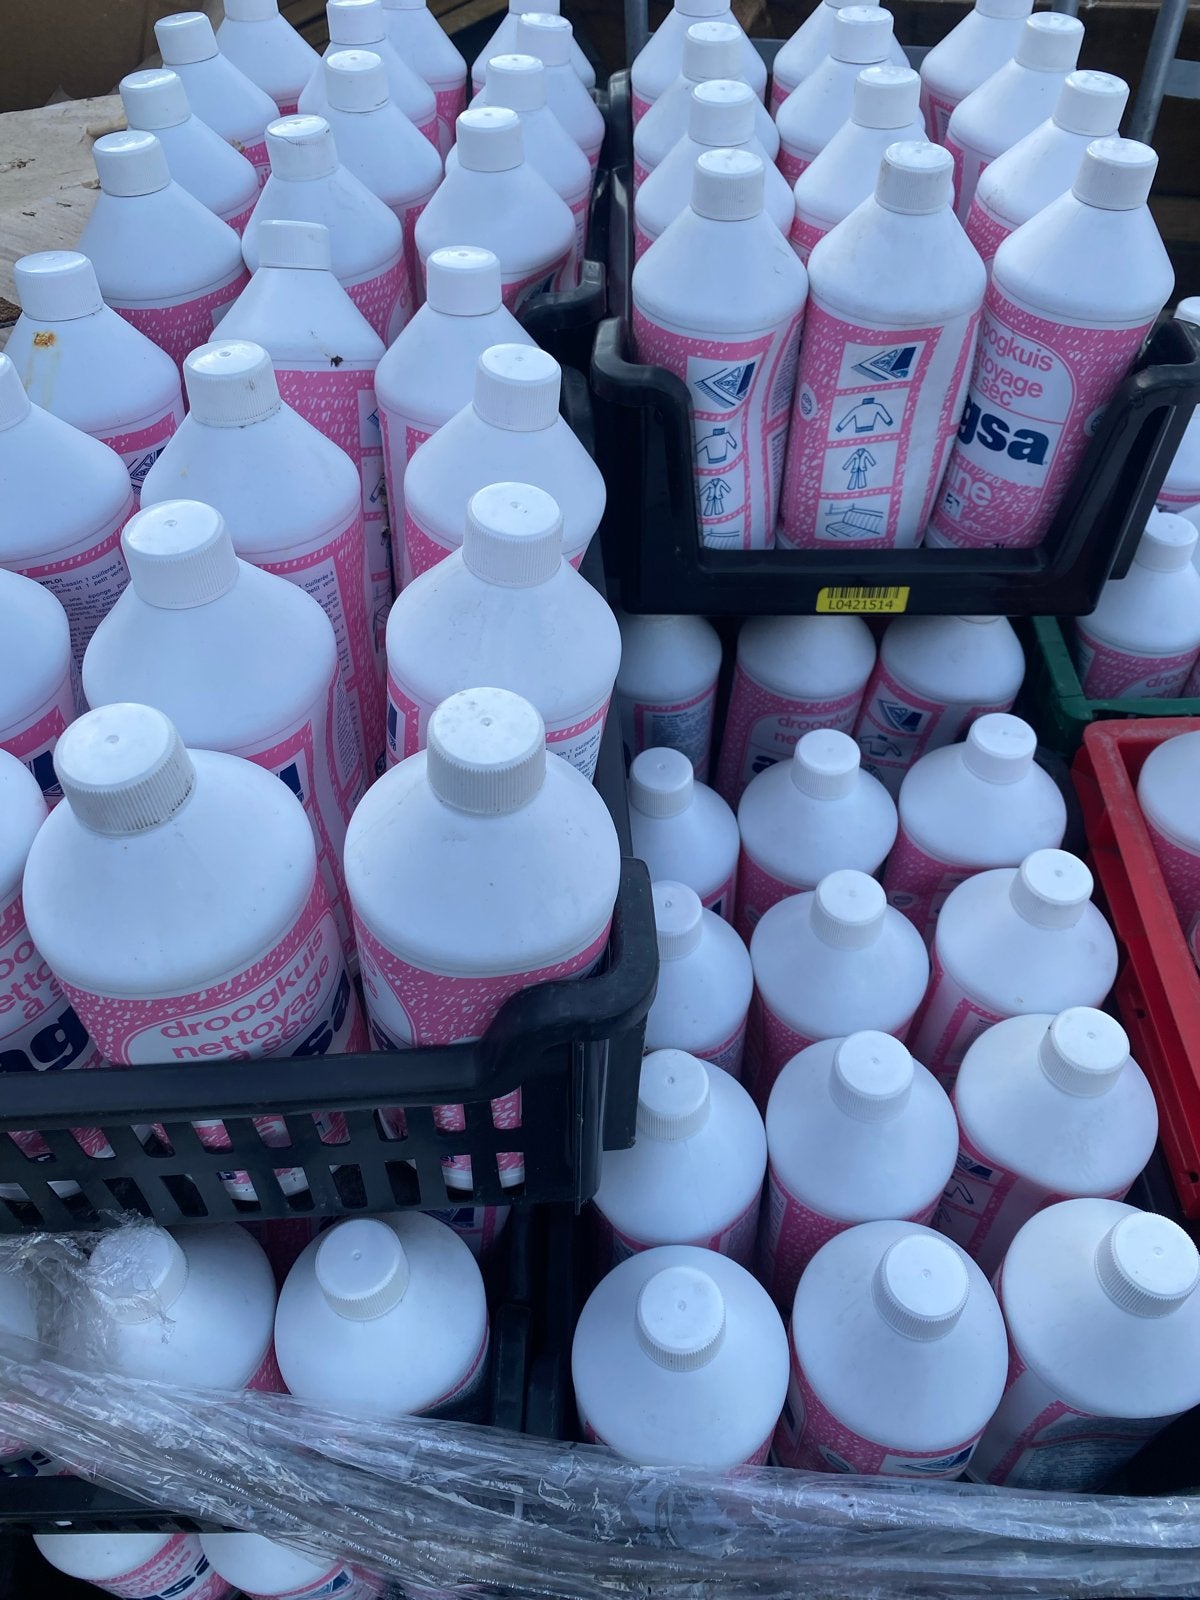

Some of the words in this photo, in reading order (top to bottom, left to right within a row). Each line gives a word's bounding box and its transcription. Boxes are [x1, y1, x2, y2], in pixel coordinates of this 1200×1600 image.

[981, 319, 1053, 372] oogkuis
[957, 394, 1049, 466] gsa
[39, 577, 63, 587] MPLOI
[161, 928, 323, 1039] droogkuis
[172, 954, 329, 1059] nettoyage
[261, 1003, 317, 1053] sec
